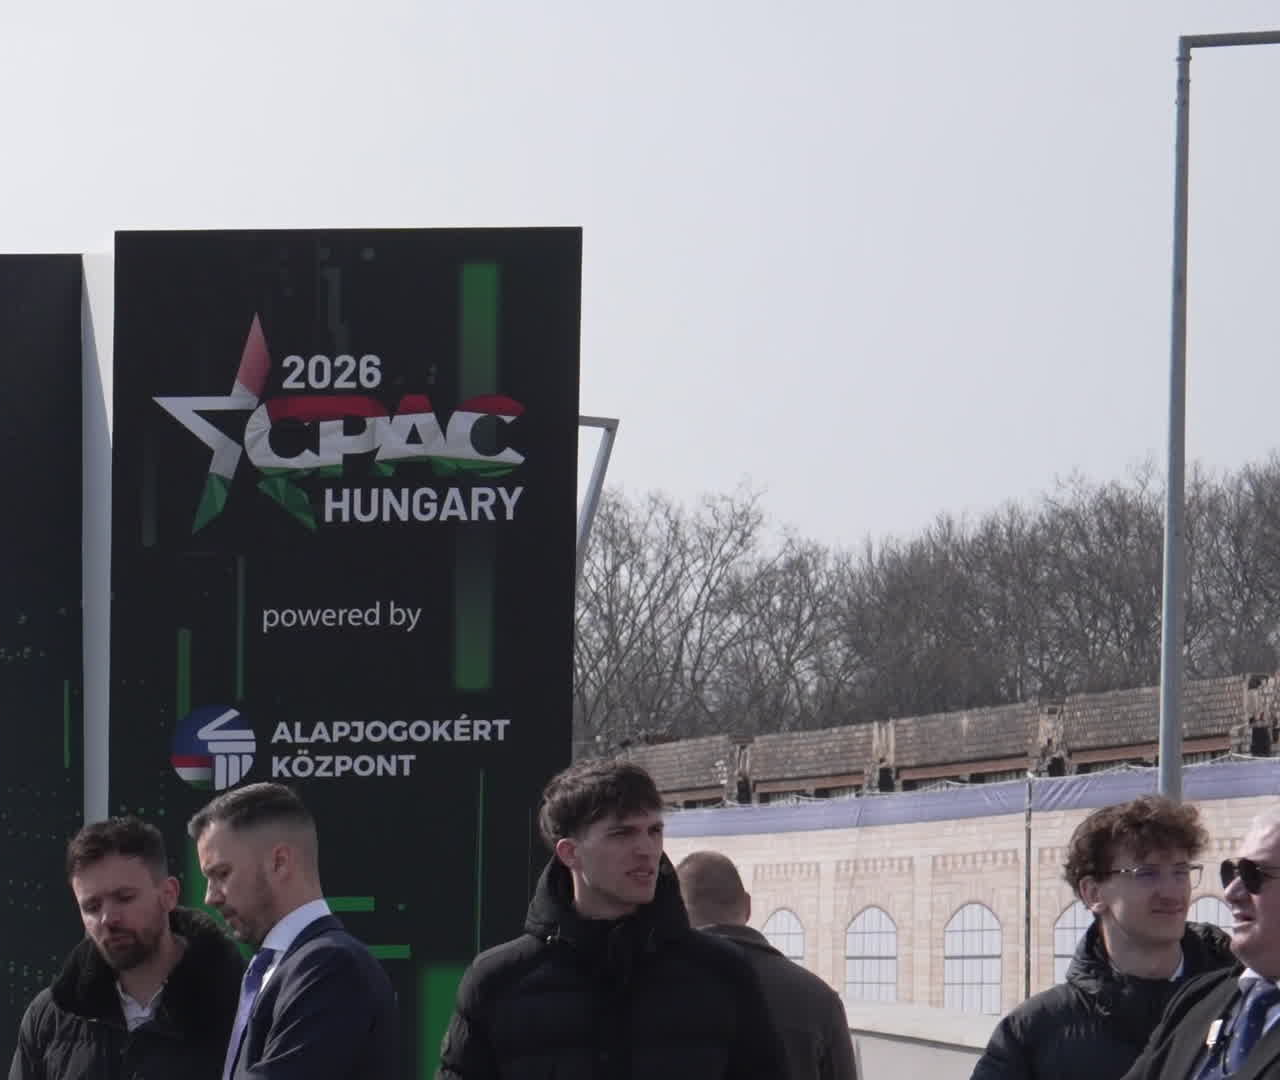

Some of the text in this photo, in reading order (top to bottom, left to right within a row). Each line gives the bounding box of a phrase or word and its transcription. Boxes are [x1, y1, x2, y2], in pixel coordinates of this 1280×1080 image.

[282, 355, 382, 390] 2026
[245, 395, 526, 479] CPAC
[325, 487, 524, 522] HUNGARY
[263, 601, 422, 632] powered by
[271, 714, 511, 743] ALAPJOGOKÉRT
[272, 749, 416, 777] KÖZPONT
